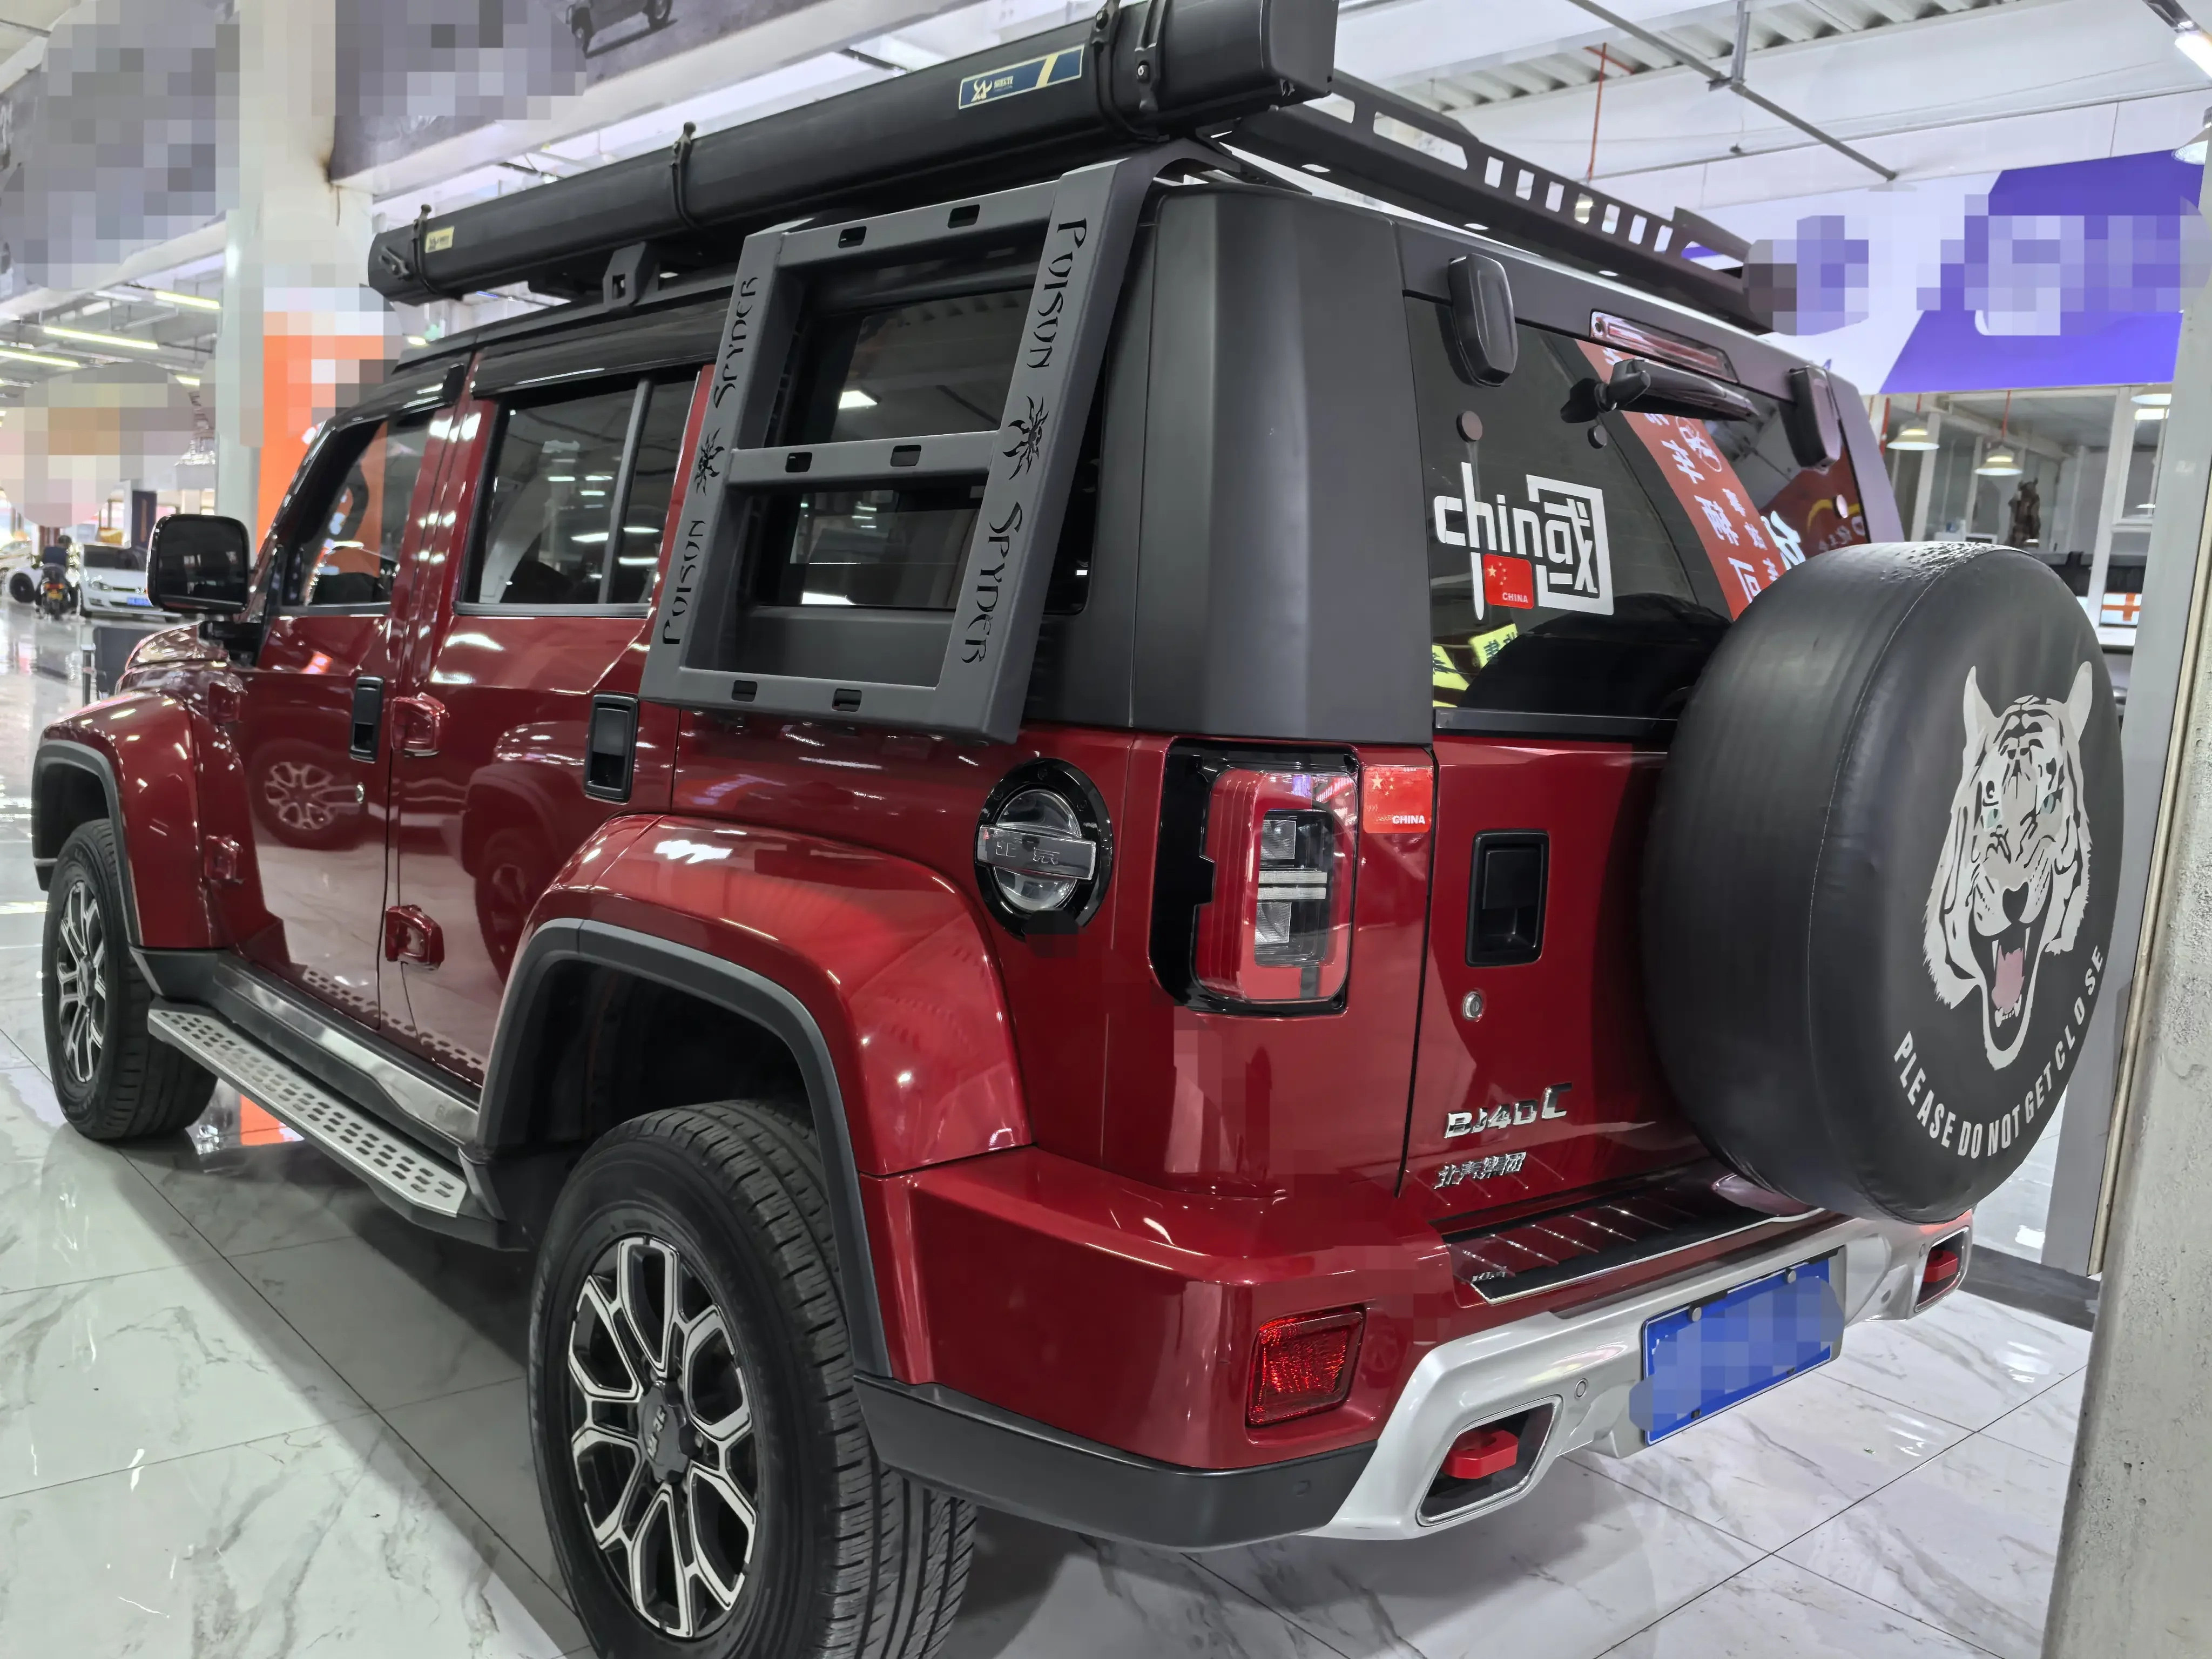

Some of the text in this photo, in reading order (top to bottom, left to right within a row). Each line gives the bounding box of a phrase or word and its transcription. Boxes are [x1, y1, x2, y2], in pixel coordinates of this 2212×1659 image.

[662, 276, 759, 645] POISON SPYDER
[962, 218, 1087, 663] POISON SPYDER
[1502, 592, 1528, 603] CHINA
[1392, 814, 1426, 825] CHINA
[1894, 945, 2103, 1158] PLEASE DO NOT GET CLOSE
